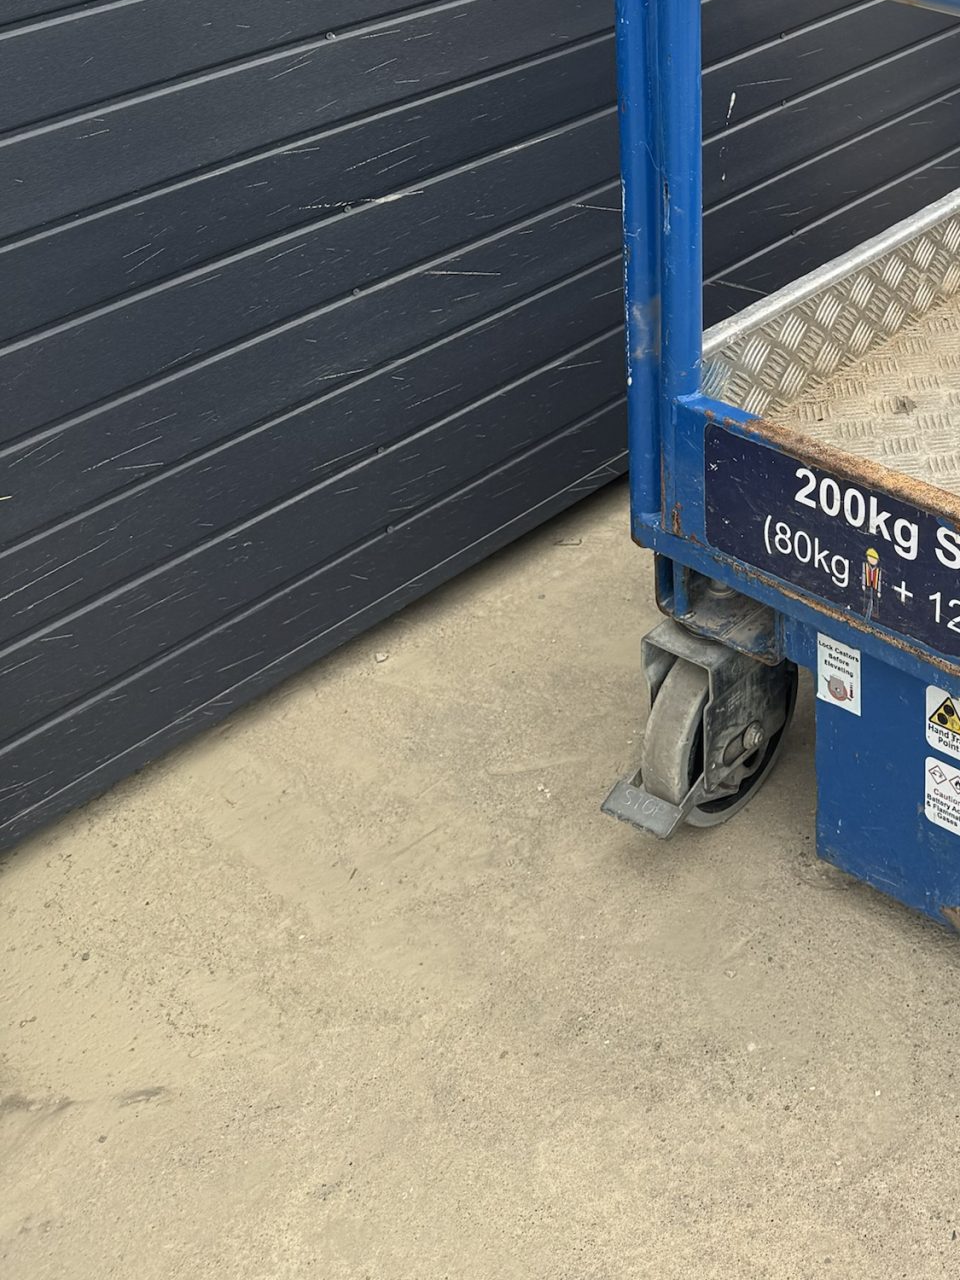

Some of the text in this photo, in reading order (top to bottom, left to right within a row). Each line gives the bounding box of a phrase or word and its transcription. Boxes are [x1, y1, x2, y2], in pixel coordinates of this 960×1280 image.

[794, 467, 919, 561] 200kg
[763, 514, 851, 589] (80kg
[818, 640, 859, 663] Lock Castors
[828, 652, 850, 667] Before
[824, 659, 854, 678] Elevating
[928, 723, 950, 739] Hand
[938, 736, 960, 752] Point
[926, 793, 951, 810] Battery
[937, 812, 958, 827] Gases
